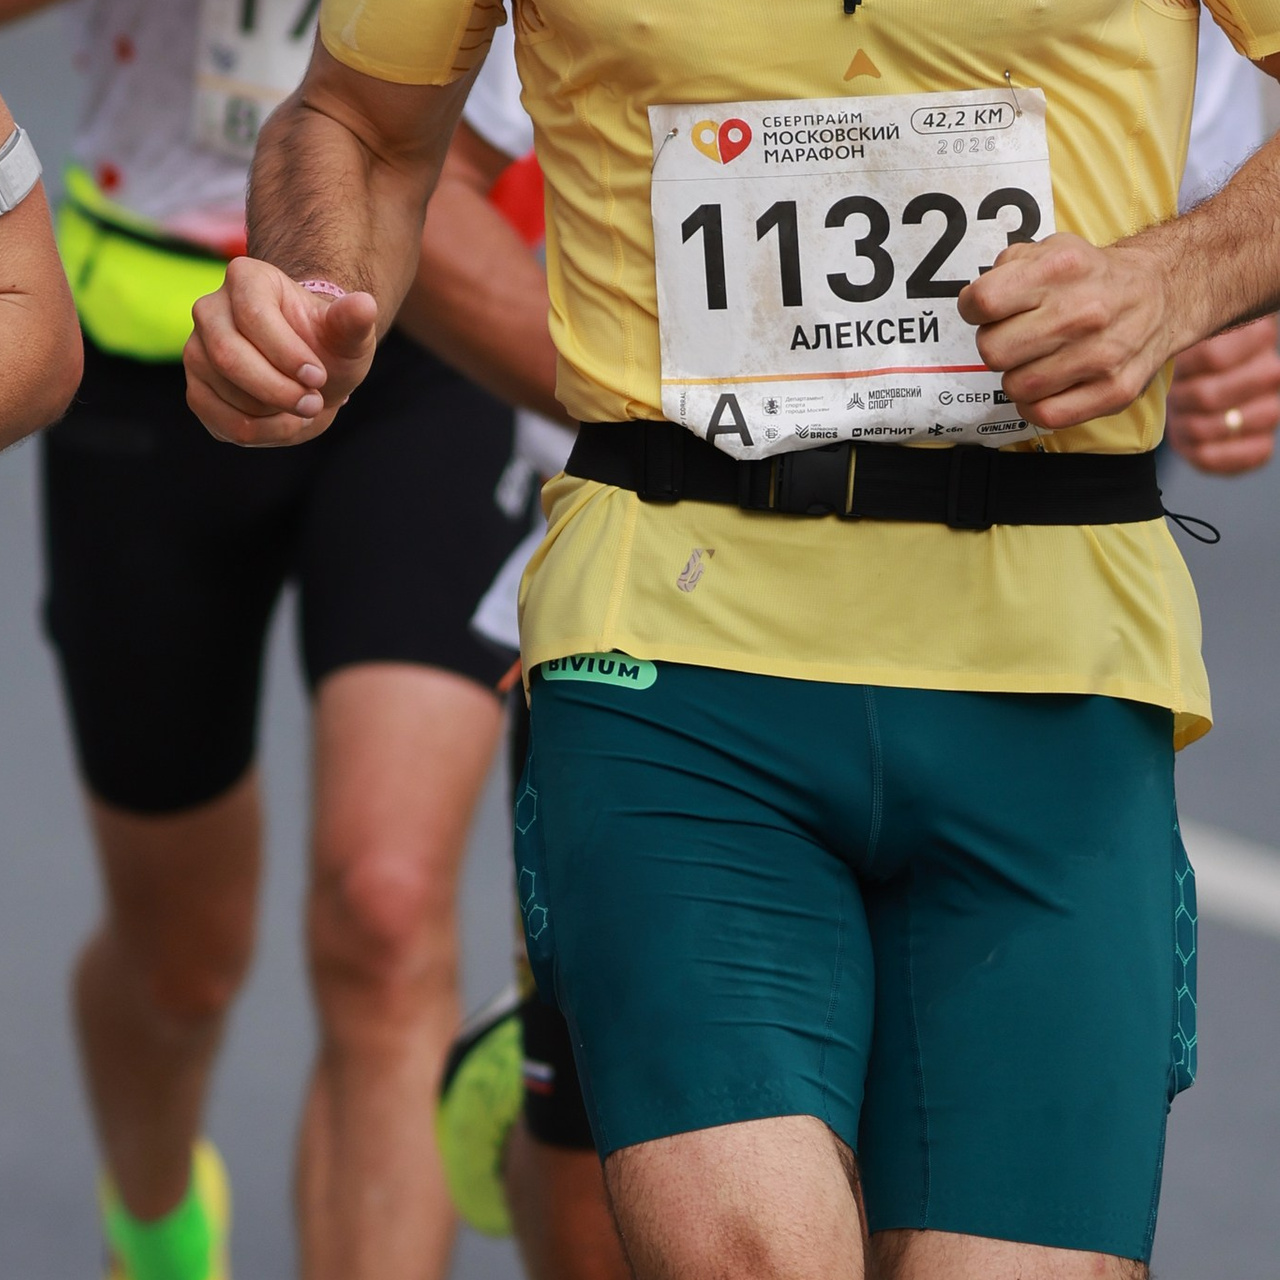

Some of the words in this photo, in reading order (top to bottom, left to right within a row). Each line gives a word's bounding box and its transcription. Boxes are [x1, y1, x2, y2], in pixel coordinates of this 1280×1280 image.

[762, 111, 863, 128] СБЕРПРАЙМ
[923, 110, 966, 129] 42,2
[763, 123, 901, 146] МОСКОВСКИЙ
[764, 145, 865, 164] МАРАФОН
[937, 136, 996, 155] 2026
[681, 187, 1042, 310] 11323
[790, 311, 940, 351] АЛЕКСЕЙ
[868, 386, 922, 400] МОСКОВСКИЙ
[956, 393, 991, 403] СБЕР
[868, 399, 894, 410] СПОРТ
[810, 431, 838, 439] BRICS
[980, 422, 1018, 433] WINLINE
[548, 656, 640, 681] BIVIUM
